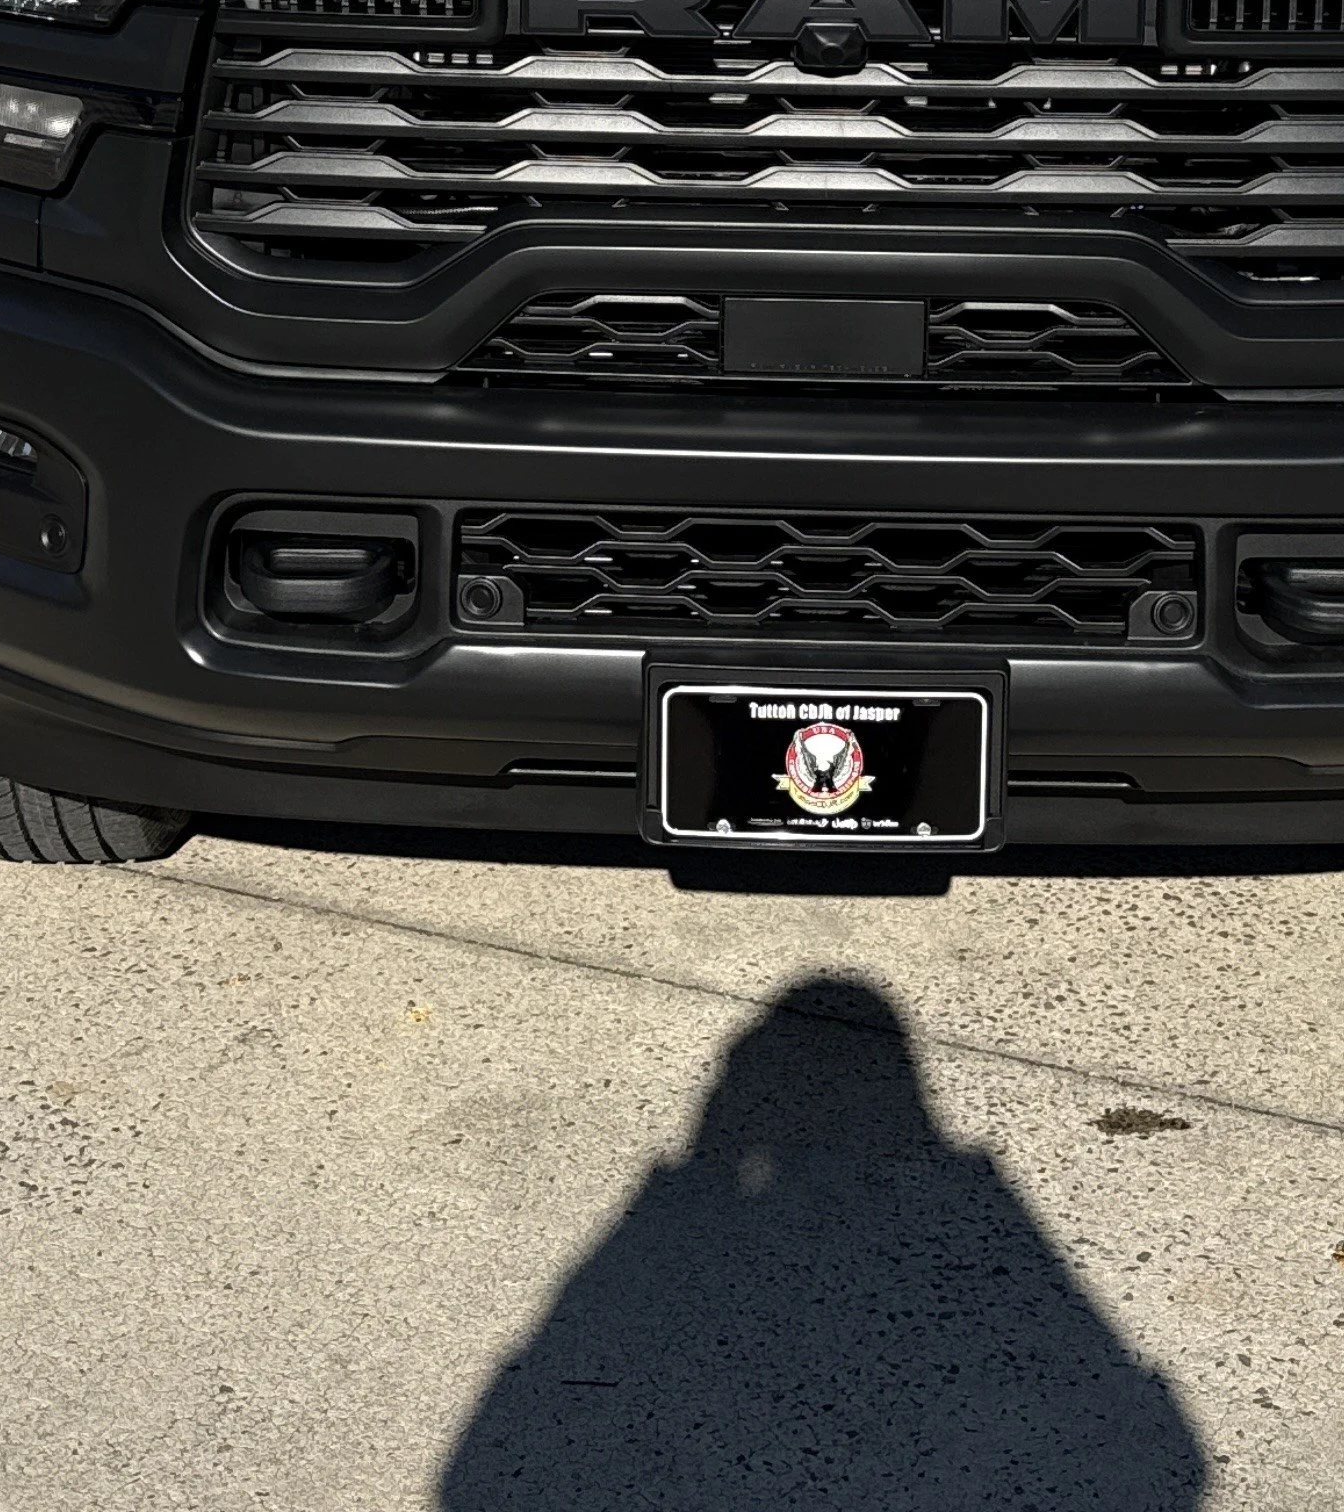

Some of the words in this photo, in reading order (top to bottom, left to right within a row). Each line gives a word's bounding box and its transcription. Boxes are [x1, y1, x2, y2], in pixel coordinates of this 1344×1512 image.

[799, 702, 833, 720] CDJR
[836, 704, 851, 720] of
[853, 705, 901, 722] Jasper
